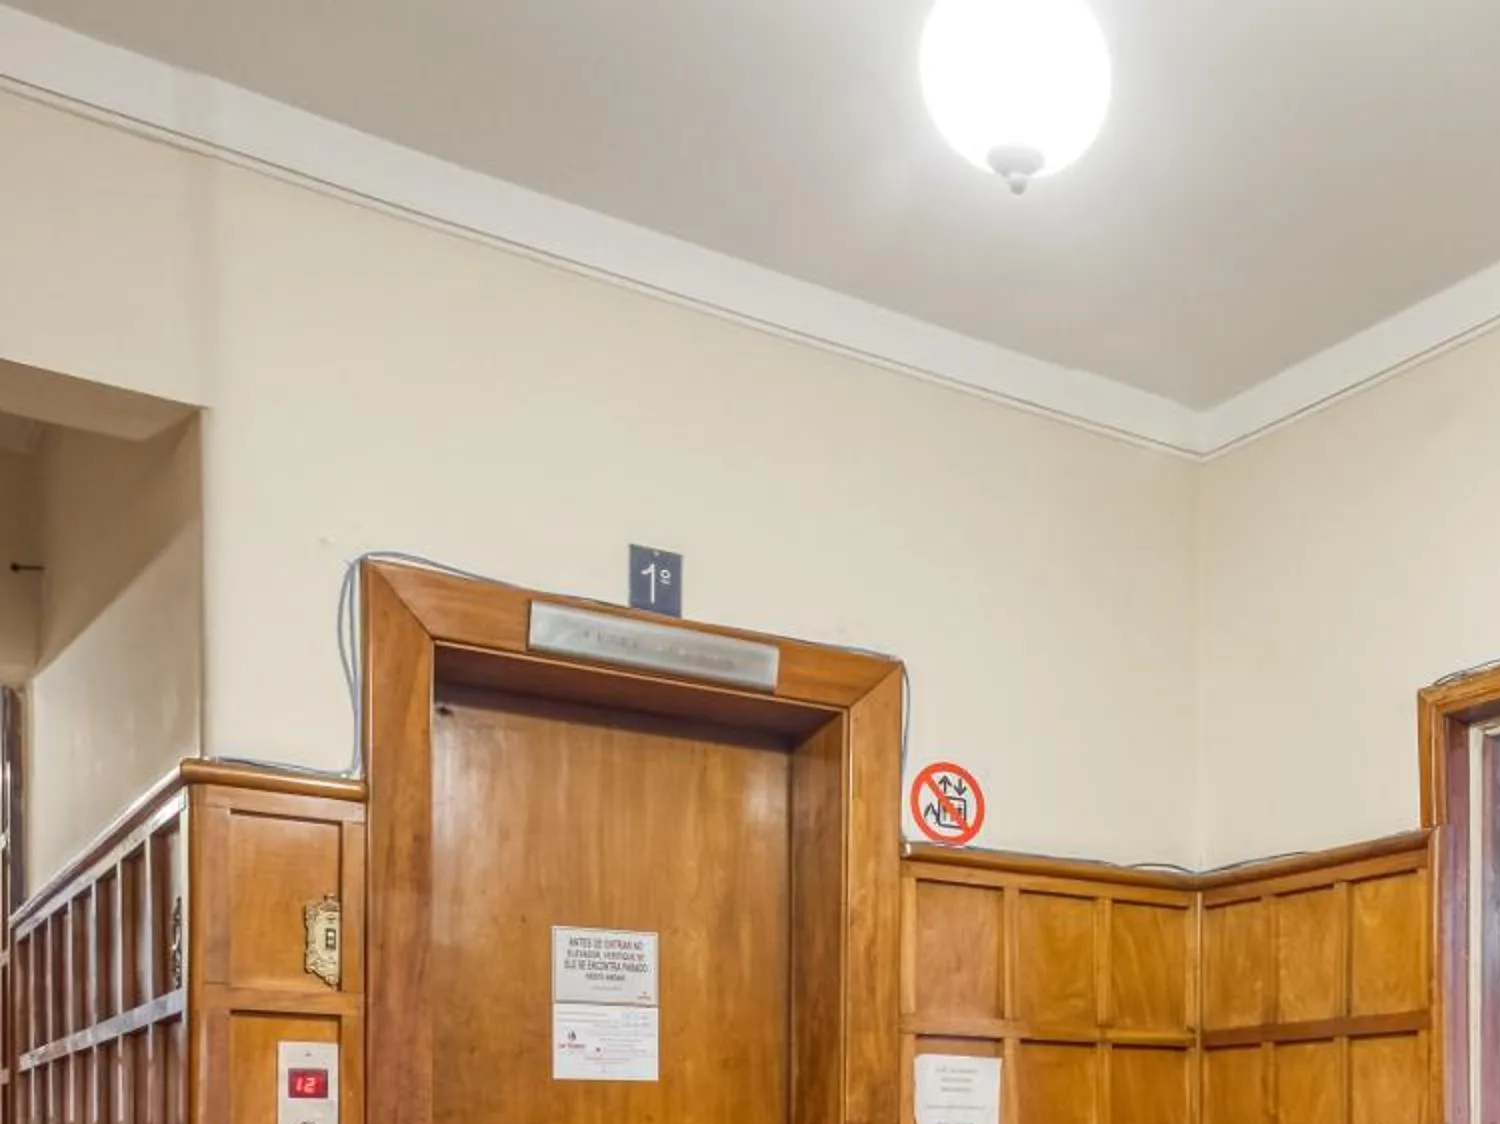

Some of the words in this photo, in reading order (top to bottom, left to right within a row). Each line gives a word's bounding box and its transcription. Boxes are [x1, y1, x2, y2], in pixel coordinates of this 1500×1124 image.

[641, 563, 671, 604] 1º
[569, 936, 592, 948] ANTES
[295, 1076, 317, 1094] 12
